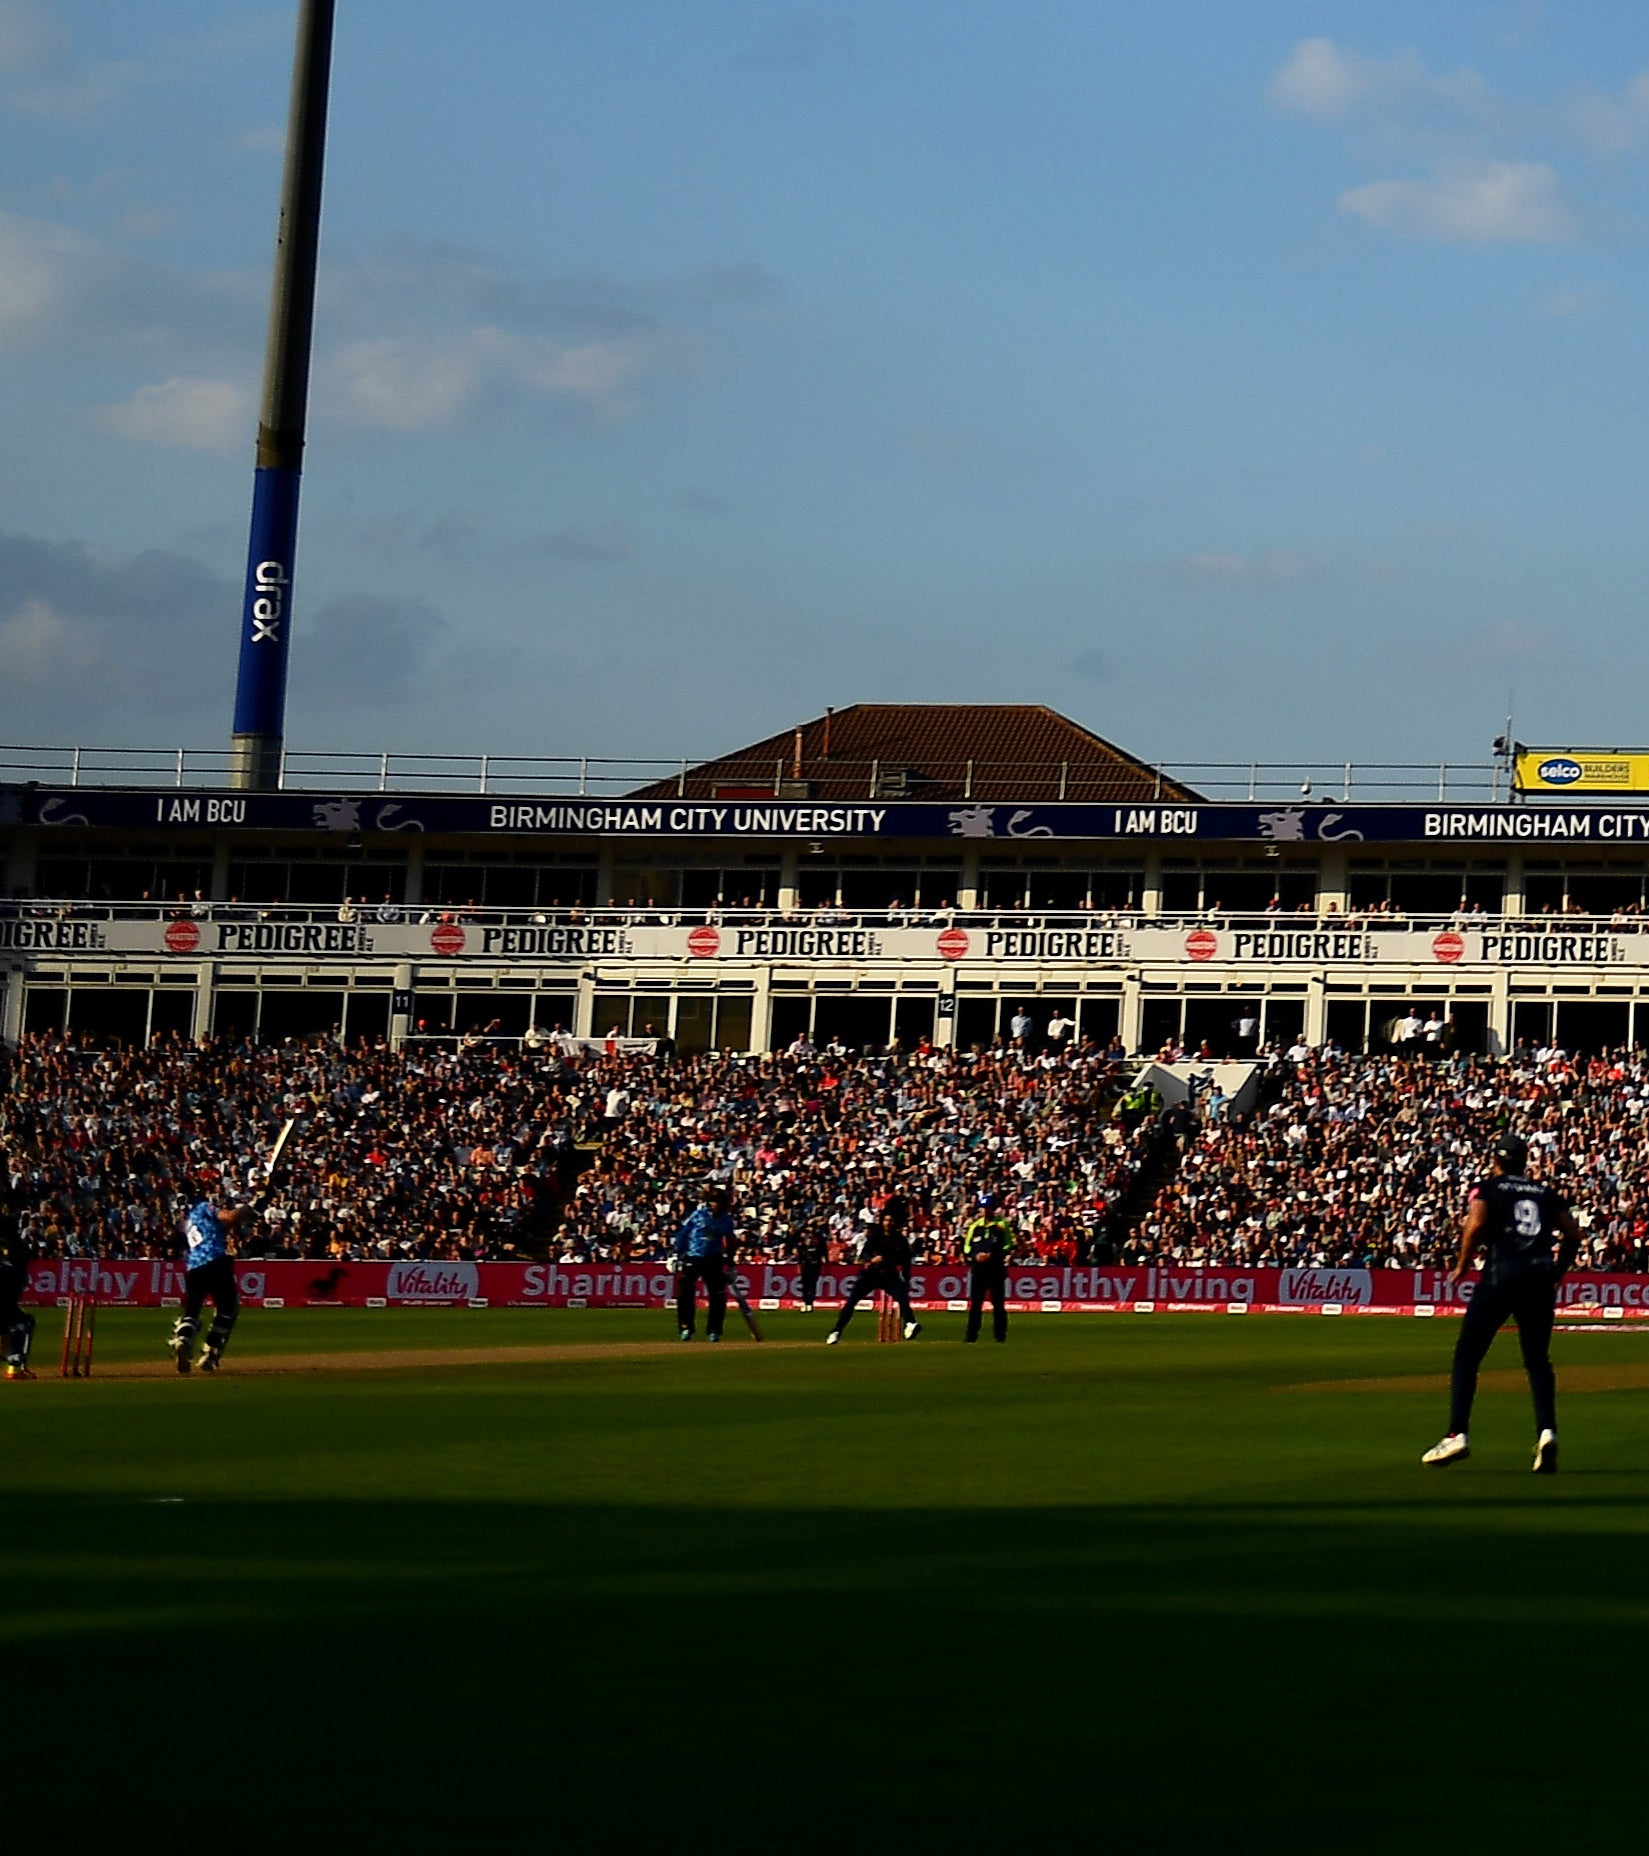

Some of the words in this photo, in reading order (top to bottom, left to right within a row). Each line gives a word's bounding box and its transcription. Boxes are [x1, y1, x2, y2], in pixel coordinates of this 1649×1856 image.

[251, 561, 288, 642] drax
[1540, 764, 1580, 778] selco
[157, 799, 162, 822] I
[168, 800, 200, 822] AM
[207, 800, 245, 823] BCU
[490, 806, 661, 830] BIRMINGHAM
[670, 808, 726, 830] CITY
[734, 809, 886, 832] UNIVERSITY
[1115, 810, 1120, 833] I
[1126, 811, 1154, 833] AM
[1160, 812, 1197, 834] BCU
[1425, 814, 1590, 837] BIRMINGHAM
[218, 924, 356, 952] PEDIGREE
[483, 928, 616, 954] PEDIGREE
[737, 930, 868, 956] PEDIGREE
[986, 932, 1114, 957] PEDIGREE
[1234, 934, 1362, 958] PEDIGREE
[1481, 936, 1608, 962] PEDIGREE
[396, 995, 408, 1008] 11
[940, 998, 954, 1010] 12
[1514, 1200, 1542, 1236] 9
[398, 1263, 470, 1299] Vitality
[524, 1265, 674, 1301] Sharing
[1148, 1268, 1255, 1304] living
[1286, 1269, 1362, 1304] Vitality
[1414, 1271, 1475, 1302] Life
